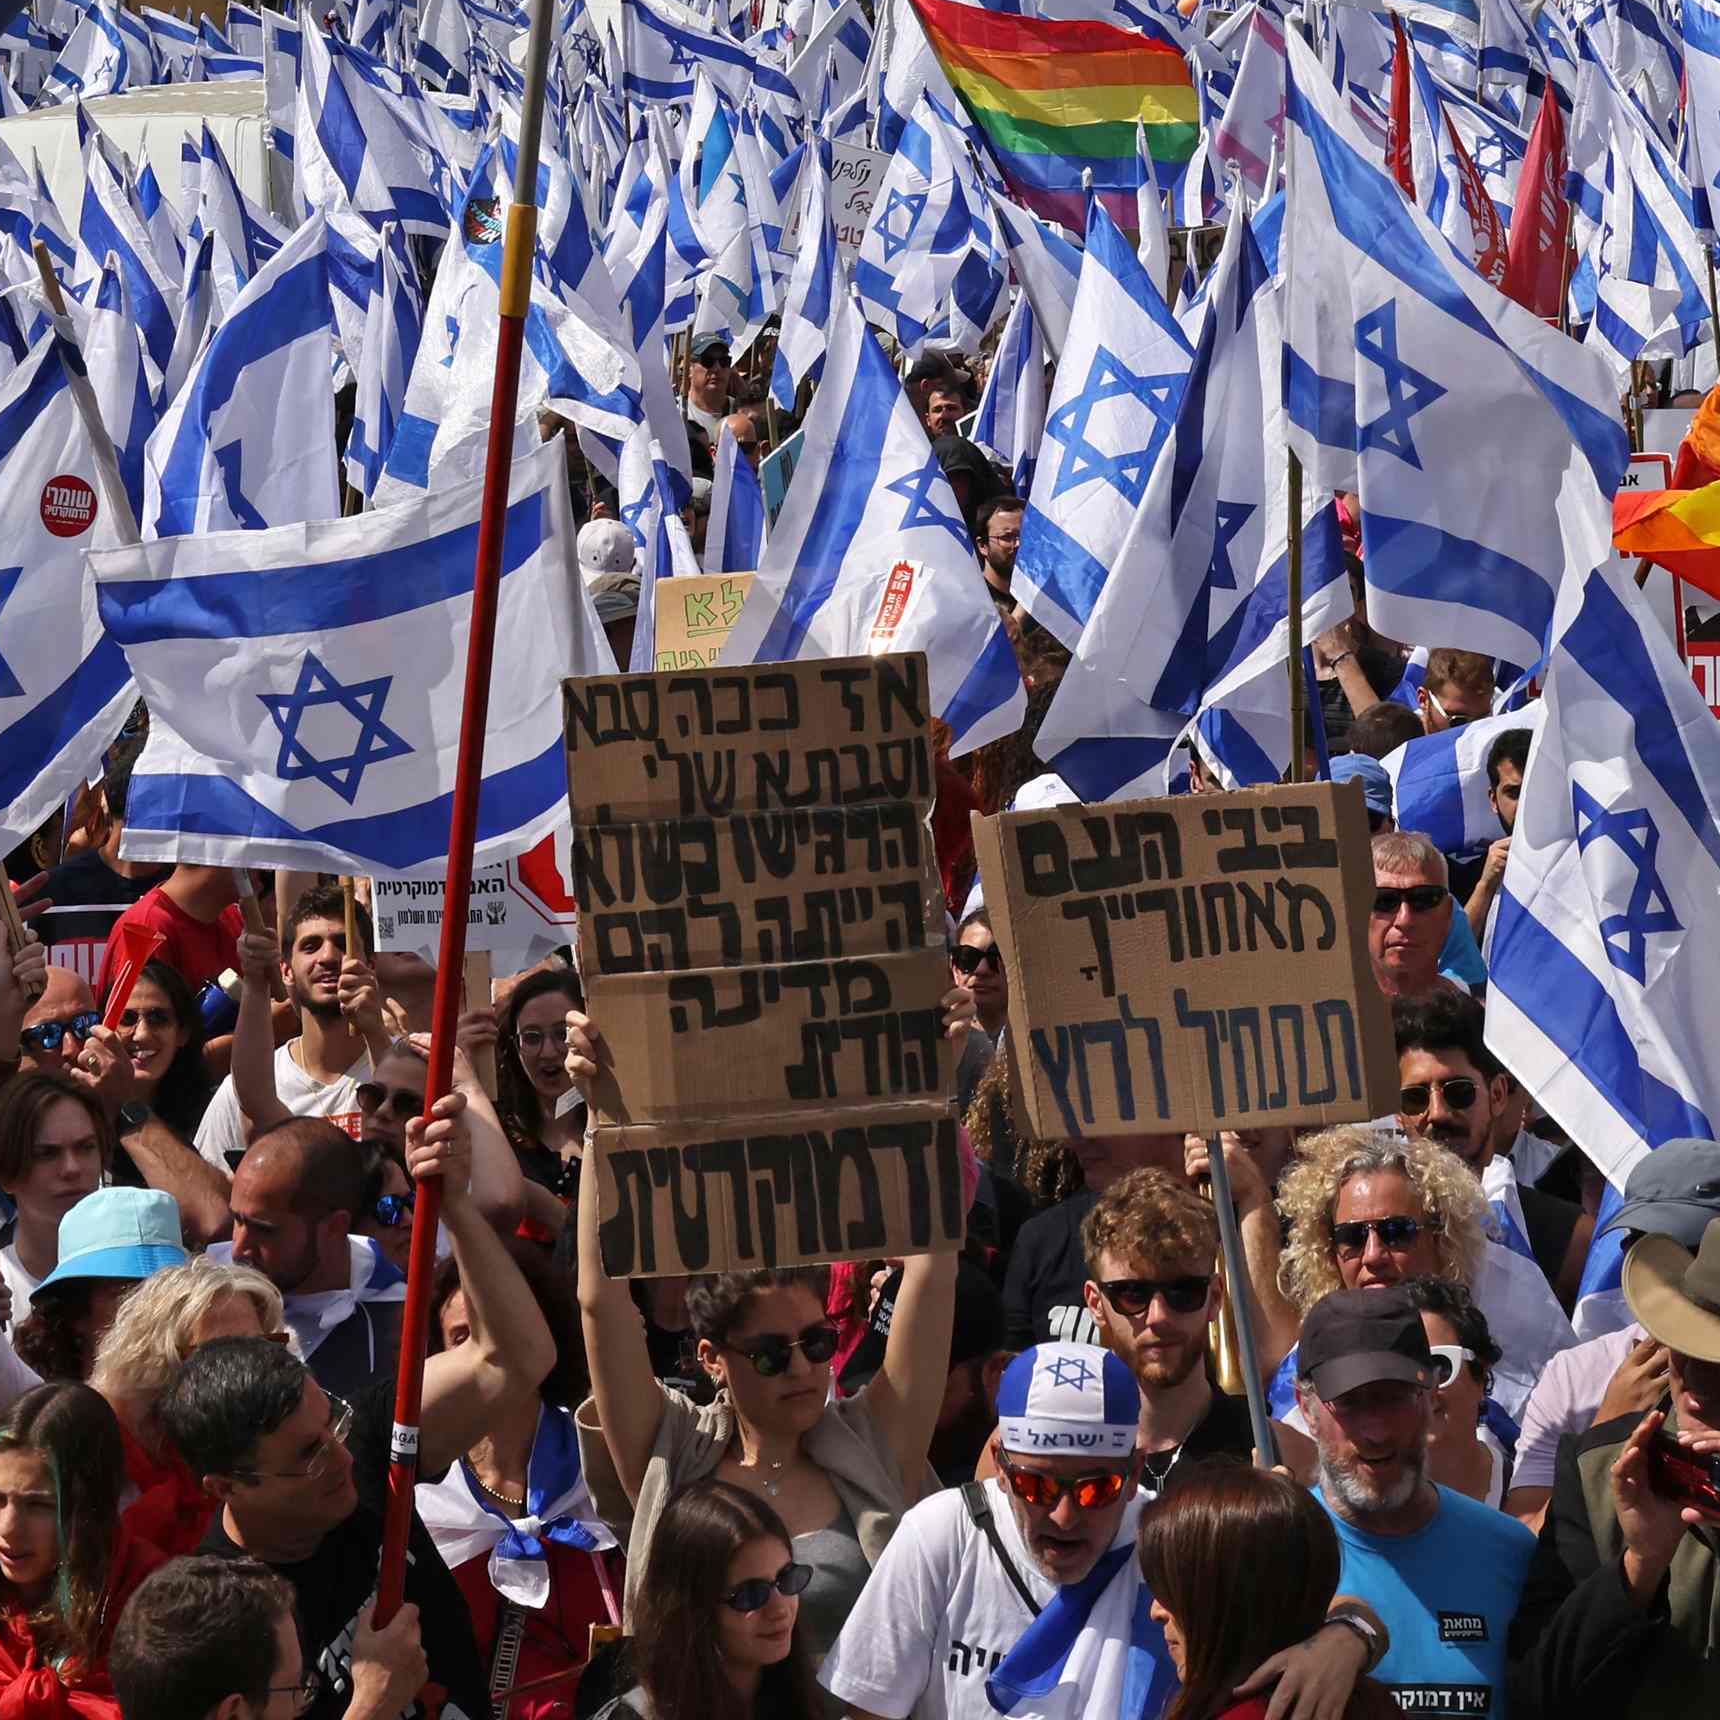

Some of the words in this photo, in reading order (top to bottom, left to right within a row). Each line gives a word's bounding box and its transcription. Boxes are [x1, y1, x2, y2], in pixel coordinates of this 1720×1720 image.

[46, 486, 92, 508] שומרי
[684, 579, 745, 627] לא
[563, 678, 660, 751] סבא
[668, 672, 801, 738] ככה
[820, 657, 927, 733] אז
[642, 737, 737, 818] שלי
[752, 736, 931, 809] וסבתא
[729, 801, 921, 884] הרגישו
[1015, 810, 1185, 898] העם
[1201, 805, 1340, 875] ביבי
[593, 895, 743, 975] להם
[754, 881, 926, 962] הייתה
[668, 958, 892, 1033] מדינה
[1029, 992, 1172, 1139] לרוץ
[1173, 987, 1364, 1119] תתחיל
[599, 1118, 962, 1279] ודמוקרטית
[1027, 1428, 1103, 1448] ישראל
[1443, 1617, 1482, 1630] מחאת
[1456, 1690, 1486, 1711] אין
